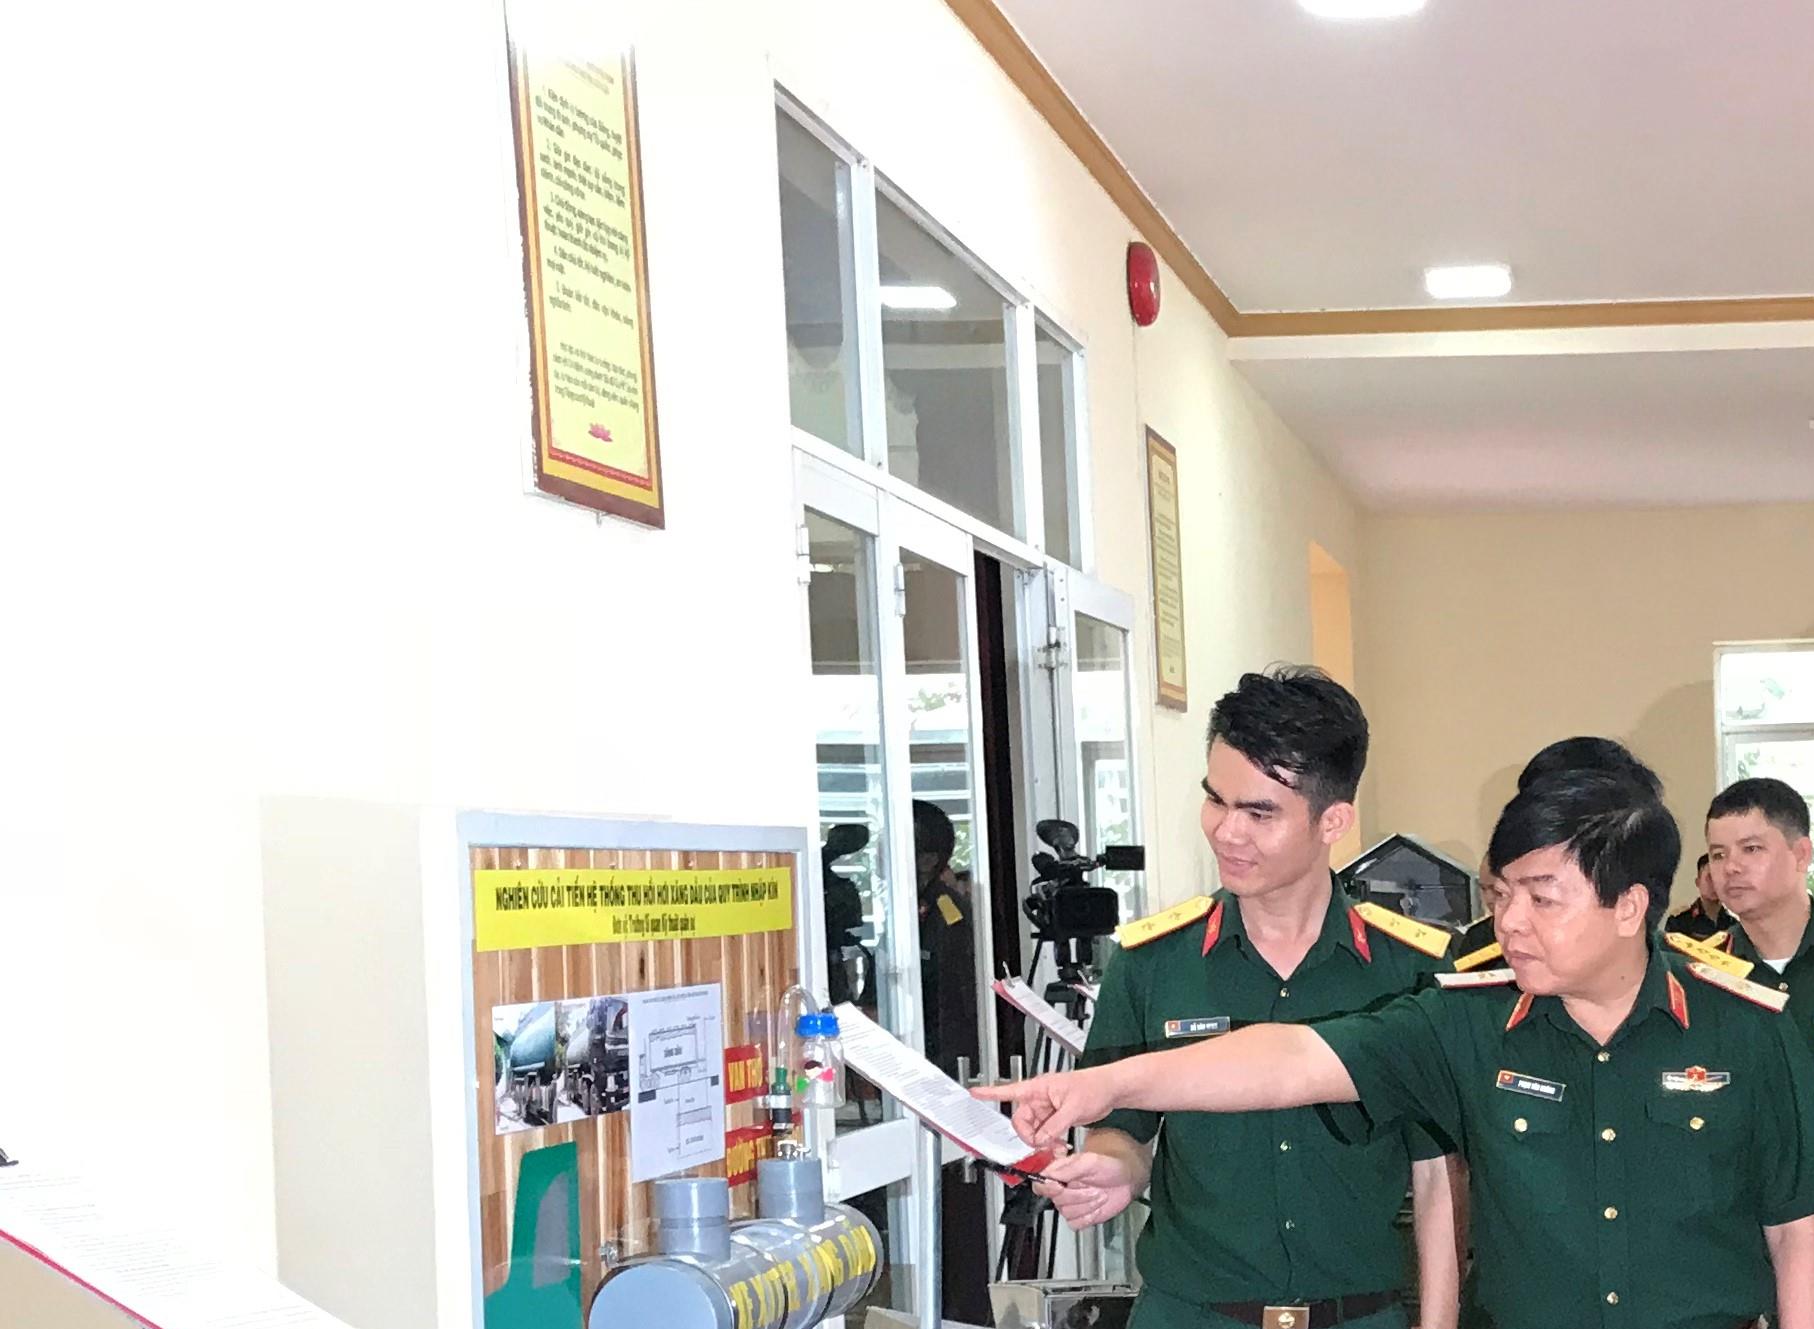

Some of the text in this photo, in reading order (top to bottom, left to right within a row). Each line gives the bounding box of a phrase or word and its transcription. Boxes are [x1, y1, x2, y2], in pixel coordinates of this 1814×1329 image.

[496, 881, 529, 911] NGHIÊN
[551, 877, 564, 908] CẢI
[566, 875, 585, 907] TIẾN
[587, 880, 597, 913] HỆ
[600, 876, 625, 906] THỐNG
[627, 884, 641, 906] THU
[643, 876, 655, 905] HỒI
[670, 879, 689, 905] XĂNG
[690, 876, 703, 904] DẦU
[704, 876, 717, 904] CỦA
[718, 883, 731, 904] QUY
[732, 878, 749, 903] TRÌNH
